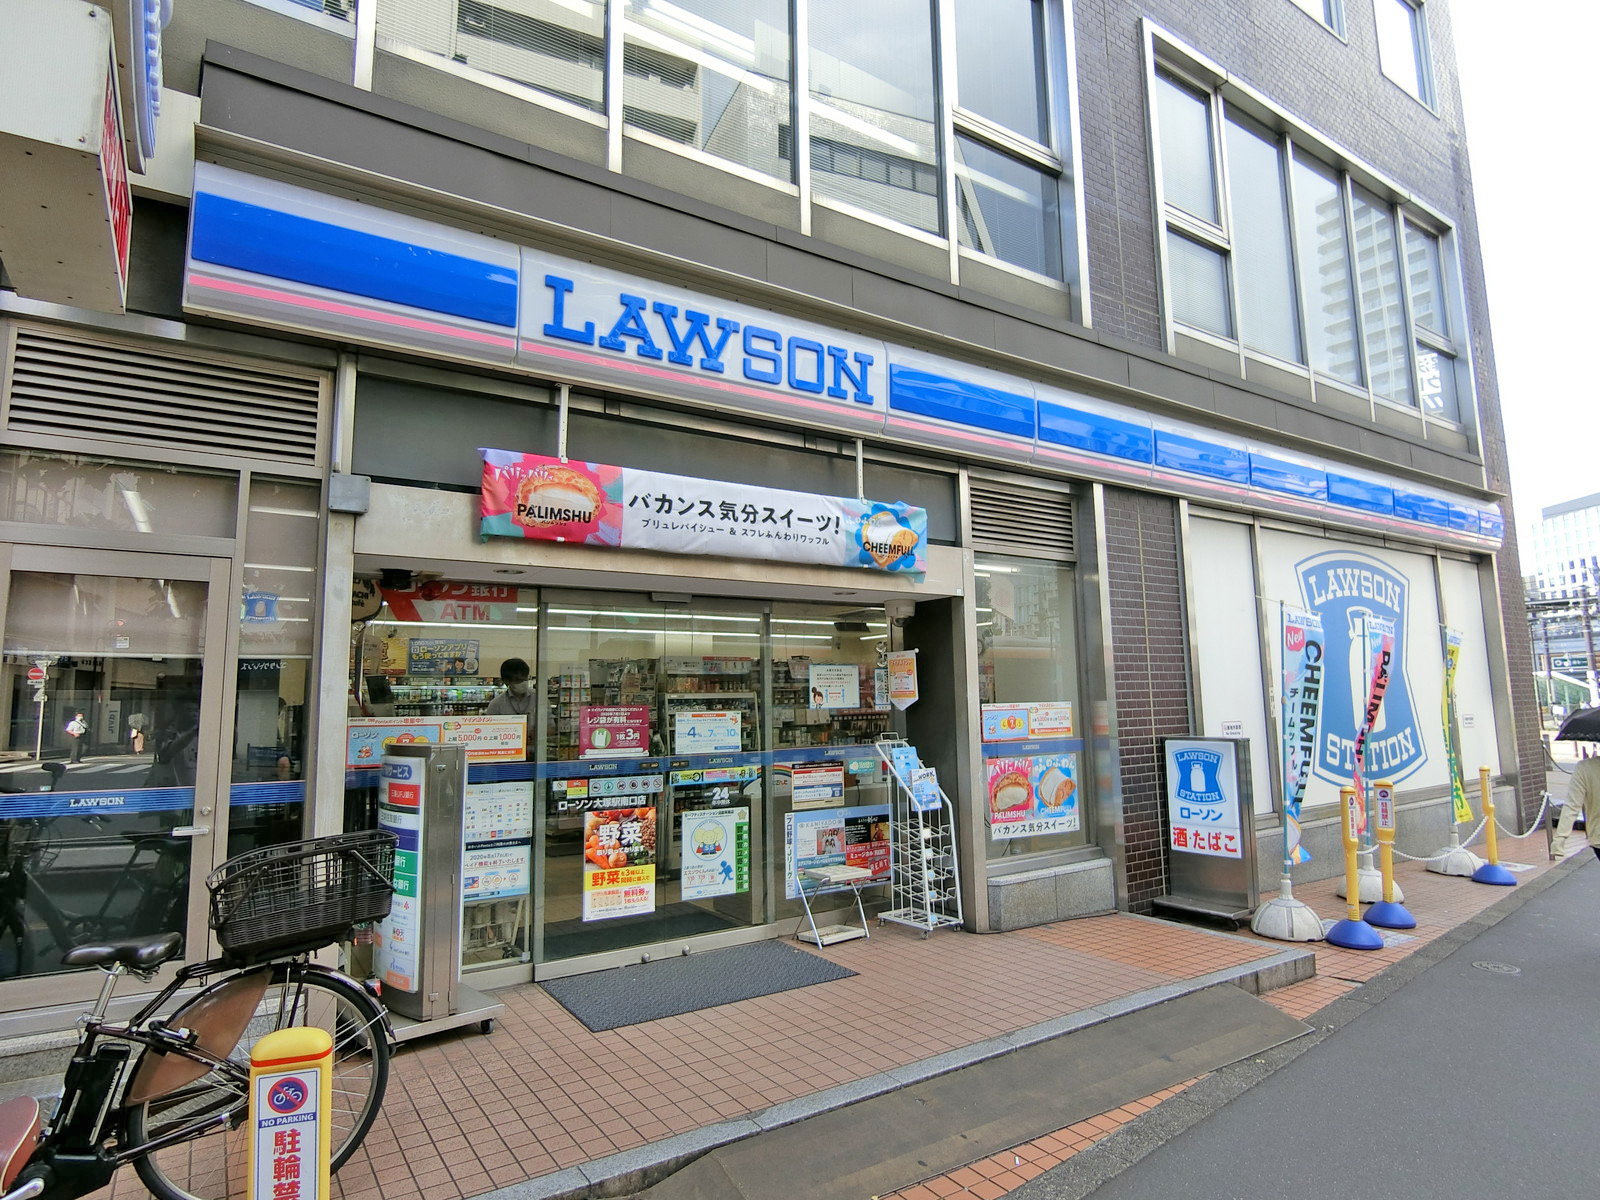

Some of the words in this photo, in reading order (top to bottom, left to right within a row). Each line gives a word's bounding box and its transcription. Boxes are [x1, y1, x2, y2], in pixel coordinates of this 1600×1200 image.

[543, 274, 874, 405] LAWSON
[628, 492, 840, 535] バカンス気分スイーツ!
[729, 527, 737, 536] &
[741, 528, 830, 546] スフレふんわりワッフル
[1308, 567, 1401, 613] LAWSON
[440, 603, 491, 621] ATM
[1177, 752, 1218, 764] LAWSON
[1326, 727, 1416, 773] STTION
[69, 797, 125, 807] LAWSON
[712, 786, 730, 800] 24
[1179, 791, 1220, 802] STATION
[558, 795, 647, 811] ローソン大塚駅南口店
[1180, 807, 1223, 821] ローソン
[599, 821, 643, 847] 野菜
[993, 817, 1076, 835] バカンス気分スイーツ!
[1173, 827, 1237, 853] 酒・たばこ
[592, 870, 621, 887] 野菜
[261, 1118, 275, 1127] NO
[276, 1113, 314, 1125] PARKING
